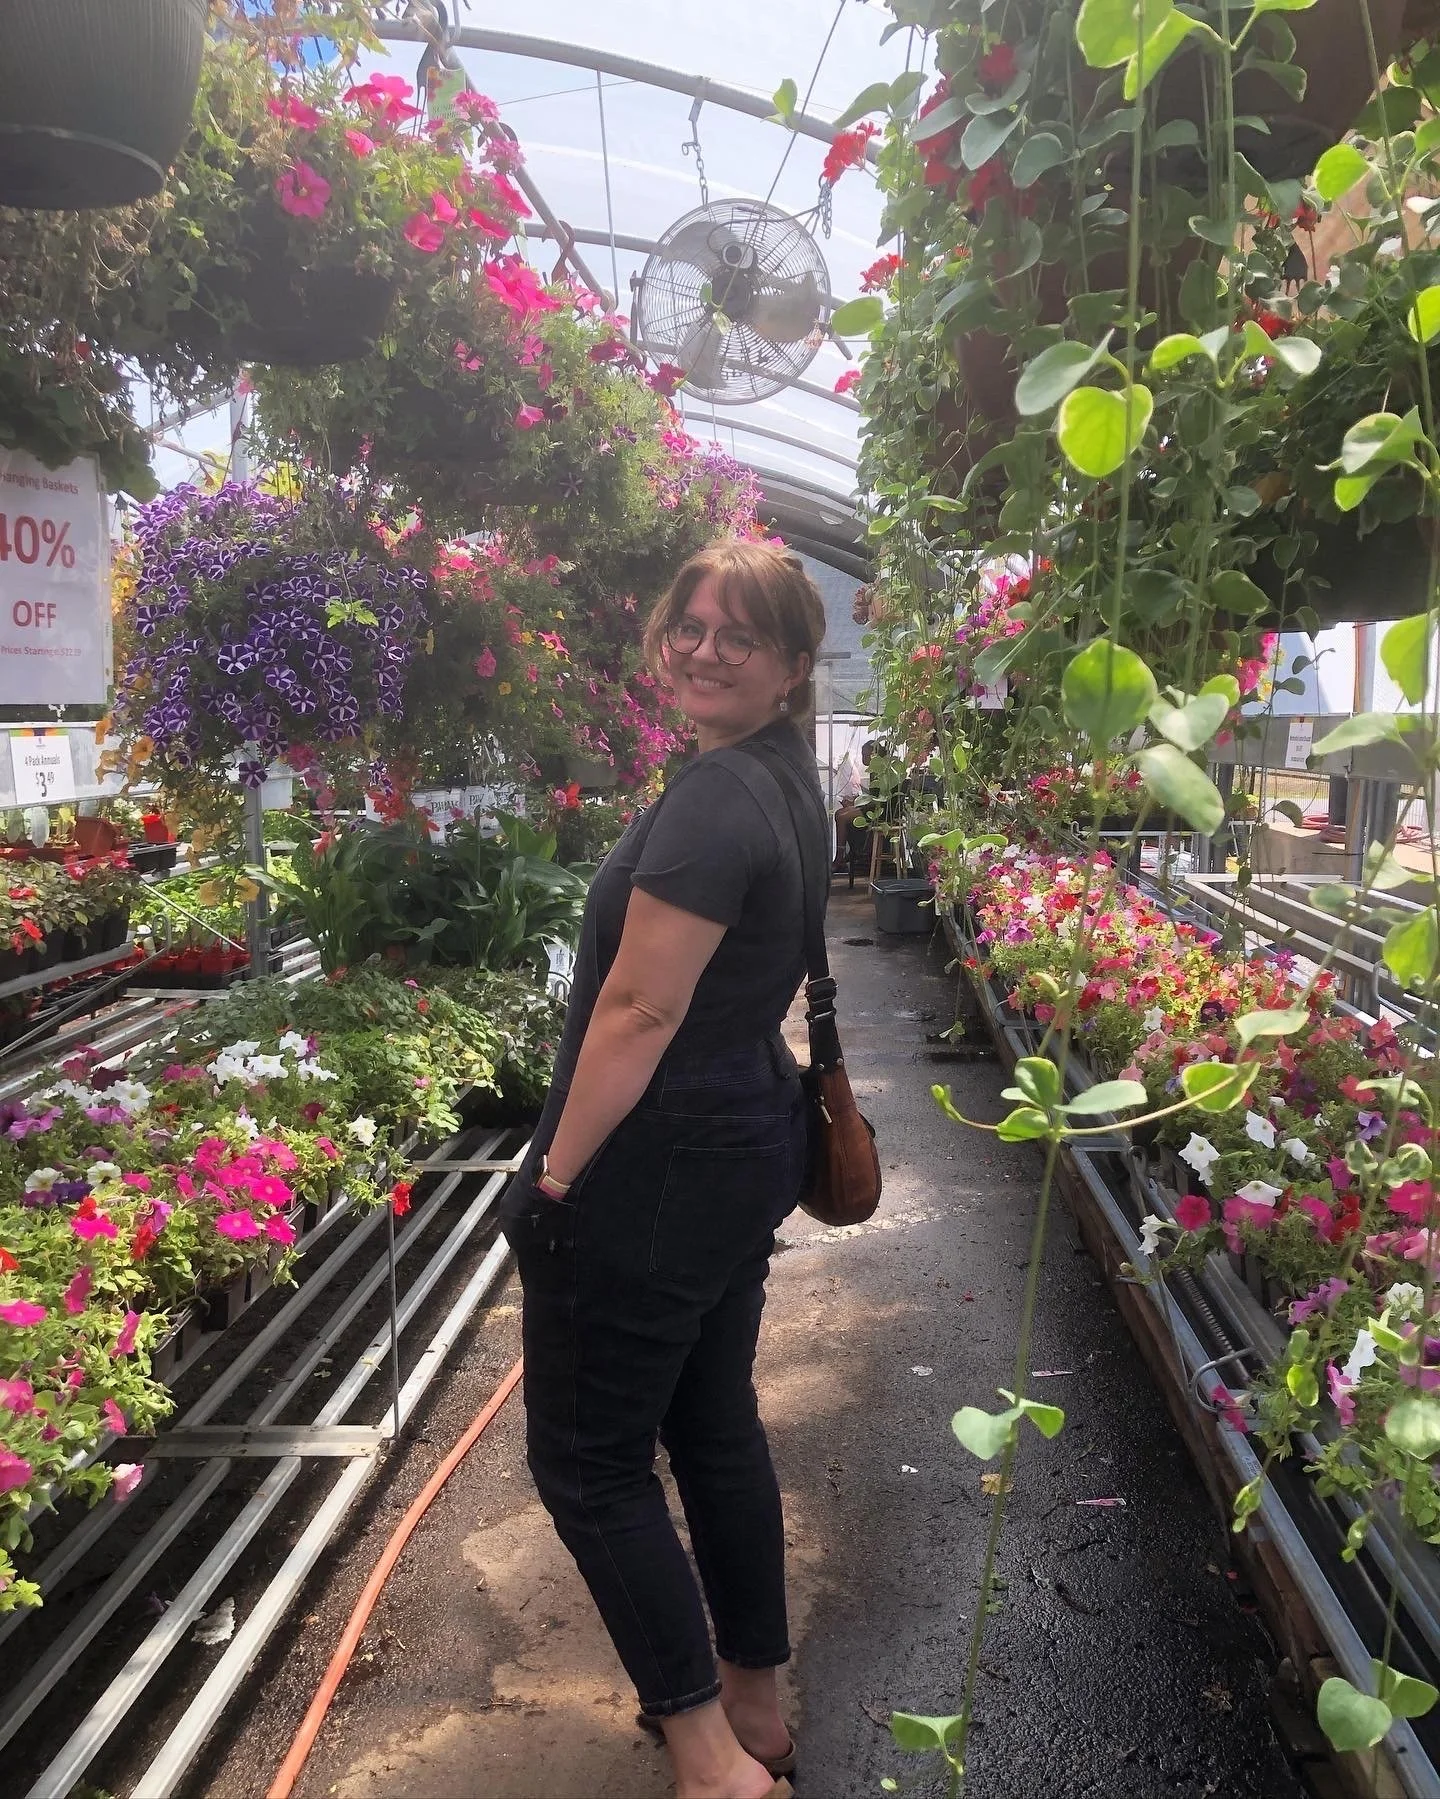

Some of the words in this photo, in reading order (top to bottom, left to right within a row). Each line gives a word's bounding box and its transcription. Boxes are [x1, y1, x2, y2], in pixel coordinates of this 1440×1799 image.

[43, 477, 79, 494] Baskets
[13, 600, 57, 628] OFF
[29, 755, 40, 766] Pack
